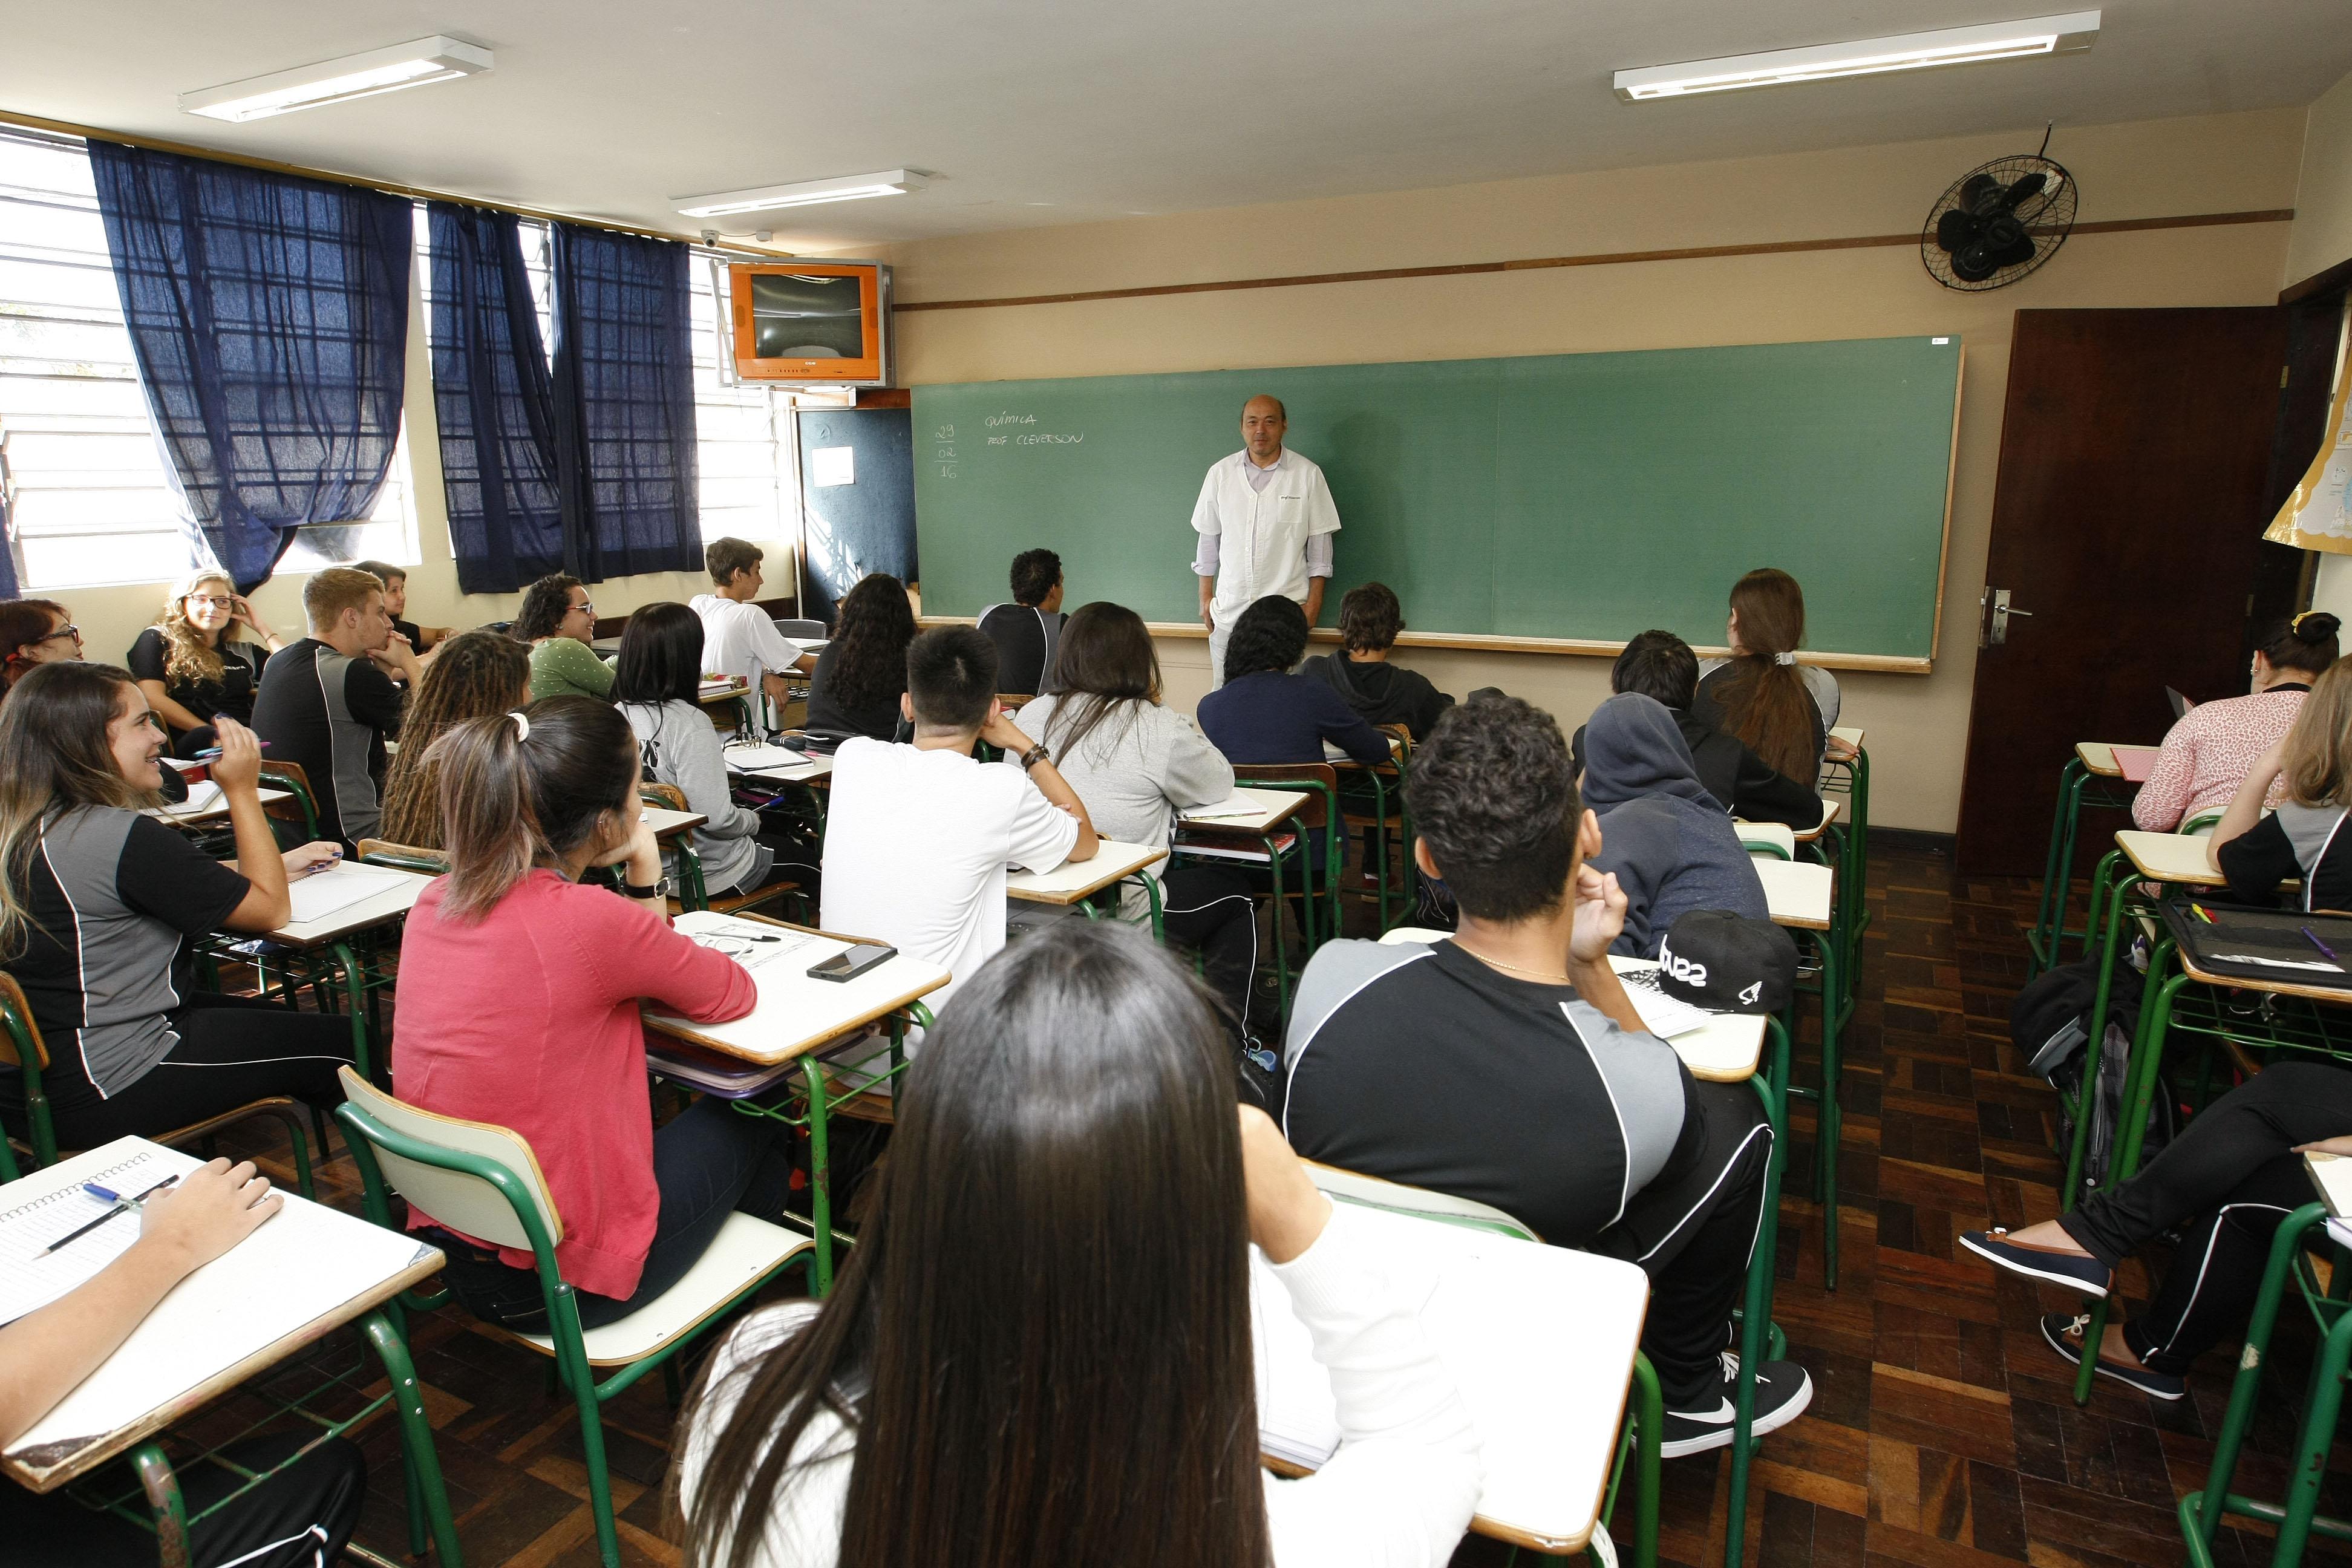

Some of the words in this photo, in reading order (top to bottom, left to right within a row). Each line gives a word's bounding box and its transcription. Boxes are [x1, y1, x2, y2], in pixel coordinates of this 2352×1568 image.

[985, 411, 1037, 428] QUÍMICA
[935, 424, 954, 439] 29
[987, 436, 1008, 445] PROF
[1016, 431, 1083, 445] CLEVERSON
[938, 447, 956, 459] 02
[940, 465, 957, 479] 16
